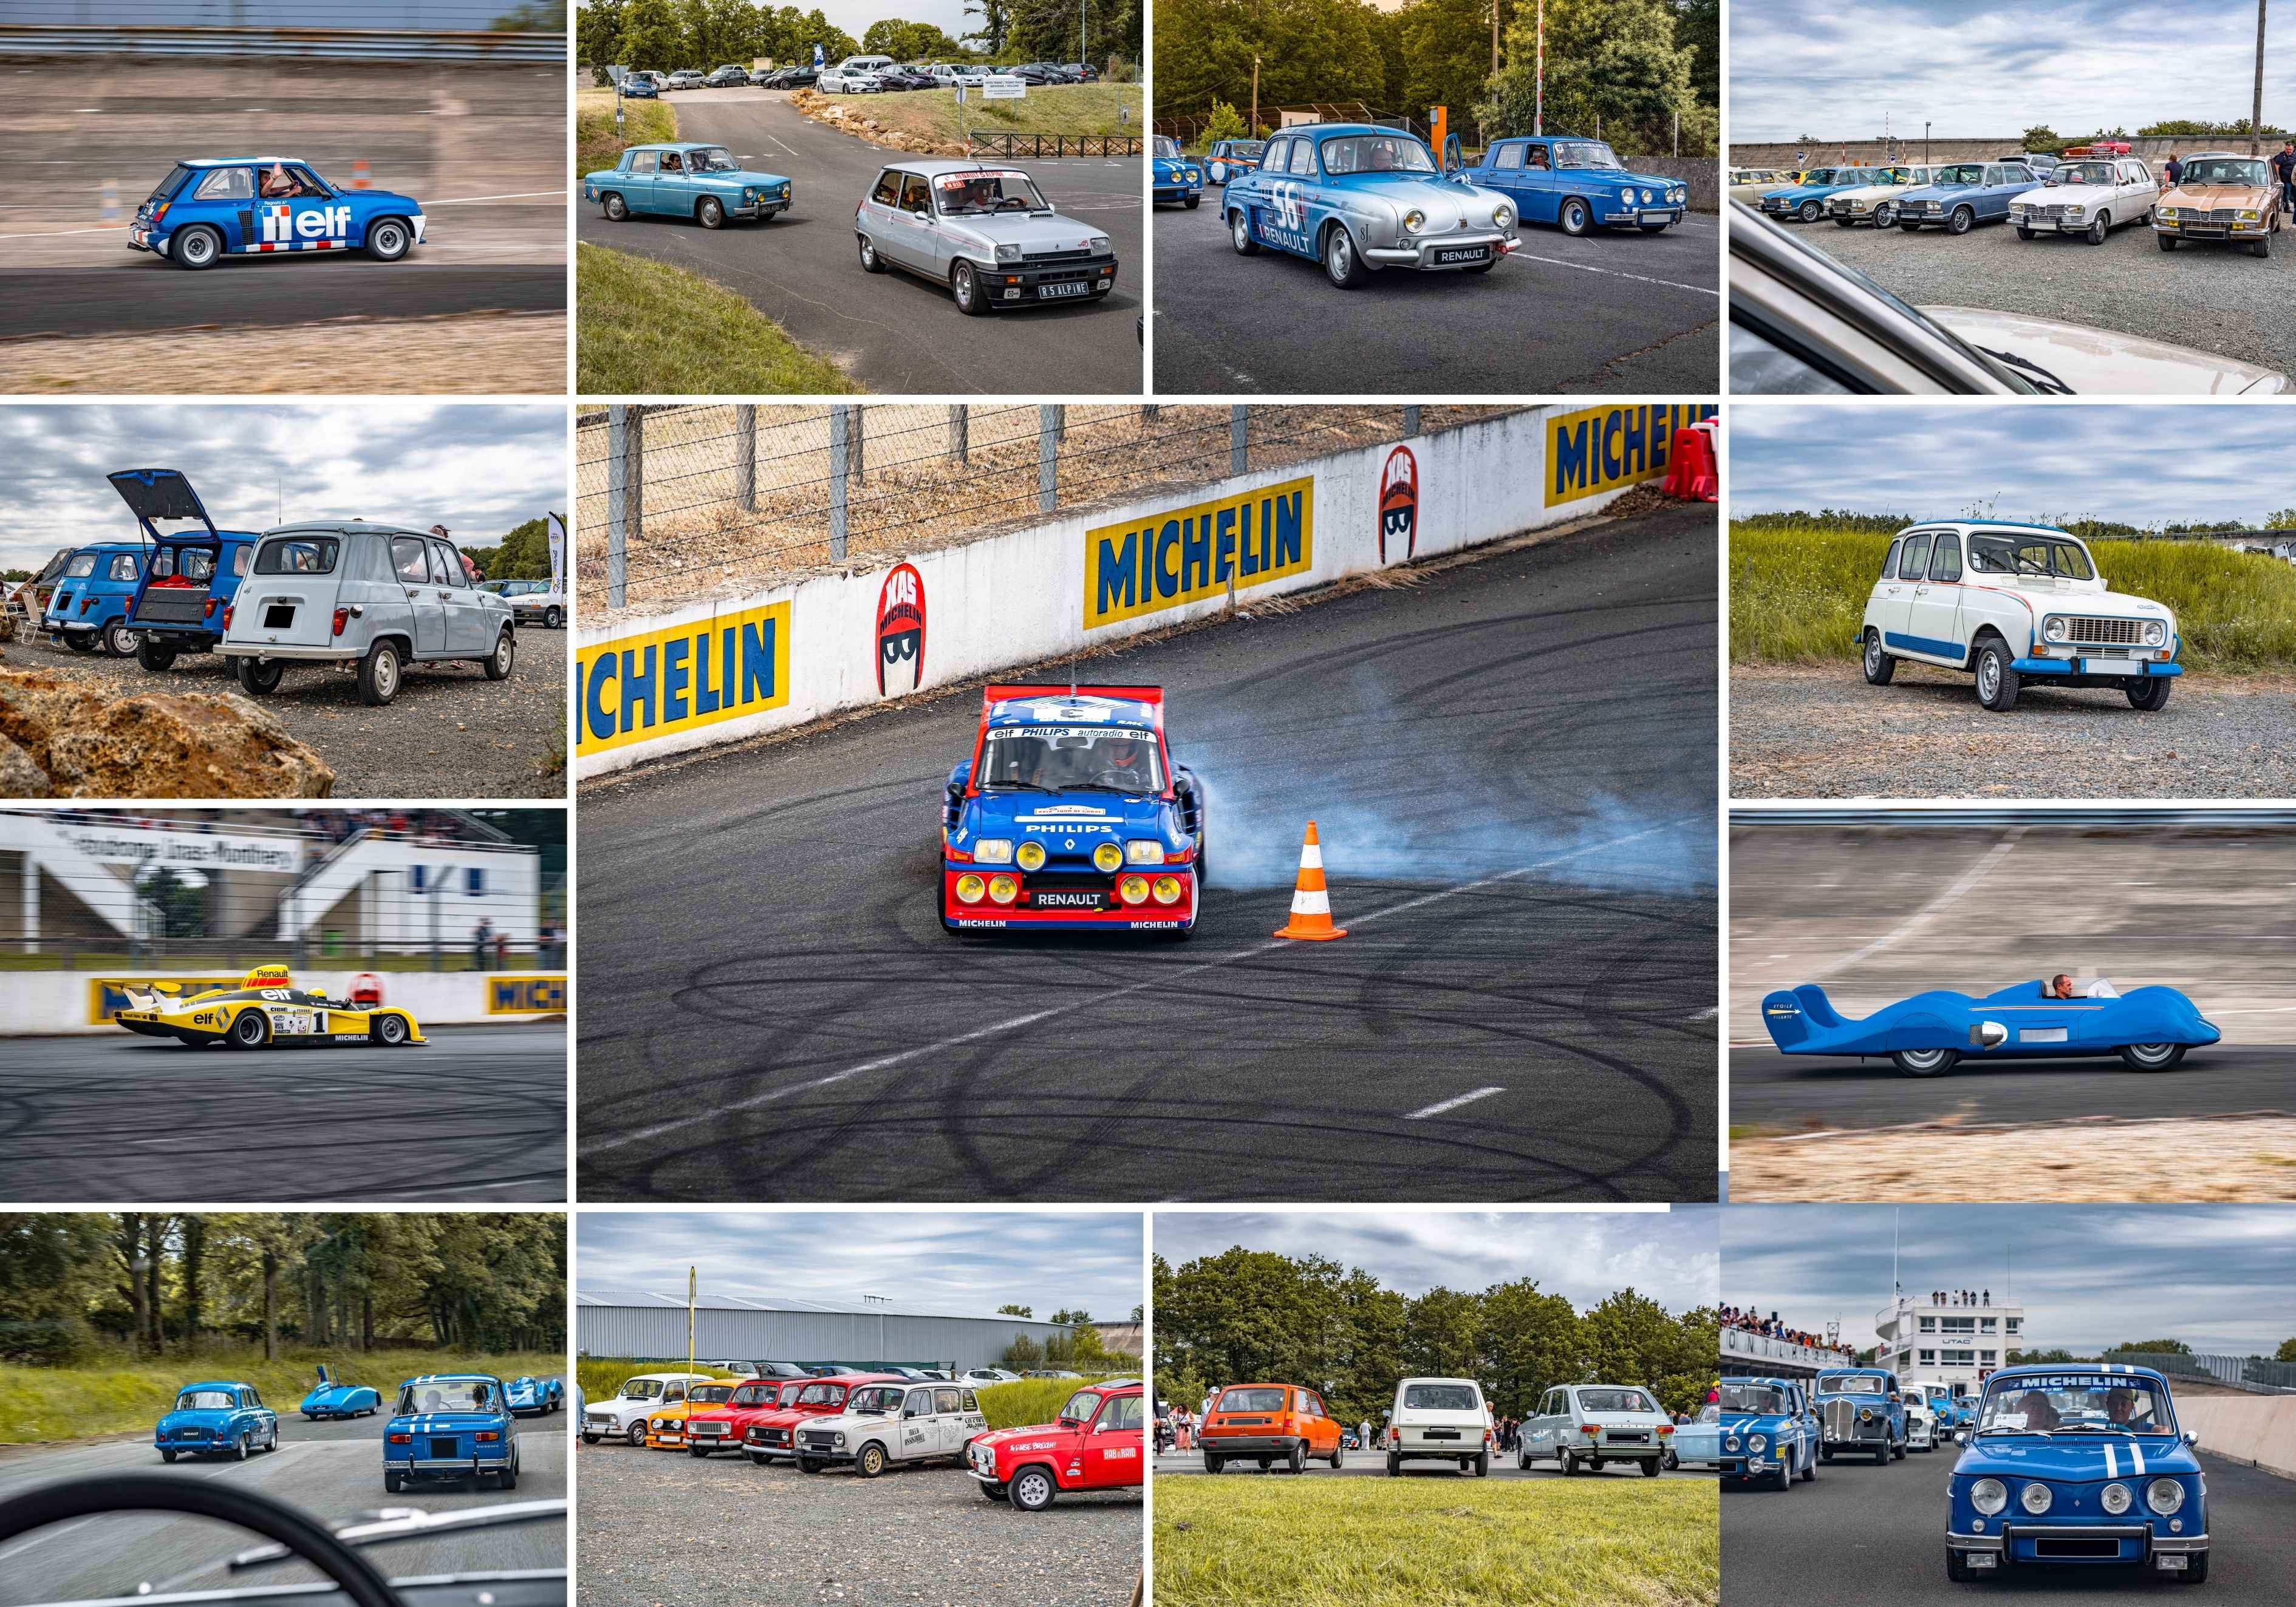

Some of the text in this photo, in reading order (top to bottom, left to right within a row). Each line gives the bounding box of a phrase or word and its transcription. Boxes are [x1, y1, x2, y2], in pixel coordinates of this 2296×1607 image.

[296, 206, 352, 237] elf
[1265, 227, 1310, 254] RENAULT
[1441, 249, 1485, 262] RENAULT
[1051, 286, 1055, 296] 5
[1385, 452, 1412, 493] XAS
[1382, 482, 1415, 510] MICHELIN
[1098, 491, 1302, 615] MICHELIN
[884, 570, 917, 615] XAS
[880, 604, 921, 636] MICHELIN
[994, 729, 1014, 738] elf
[1078, 729, 1123, 737] autoradio
[1129, 731, 1149, 739] elf
[1038, 895, 1101, 905] RENAULT
[261, 989, 292, 1000] elf
[194, 1013, 213, 1024] elf
[313, 1011, 325, 1033] 1
[2021, 1377, 2127, 1387] MICHELIN
[253, 1433, 270, 1443] RENAULT
[1104, 1450, 1116, 1458] BAB
[1121, 1448, 1135, 1458] RAID
